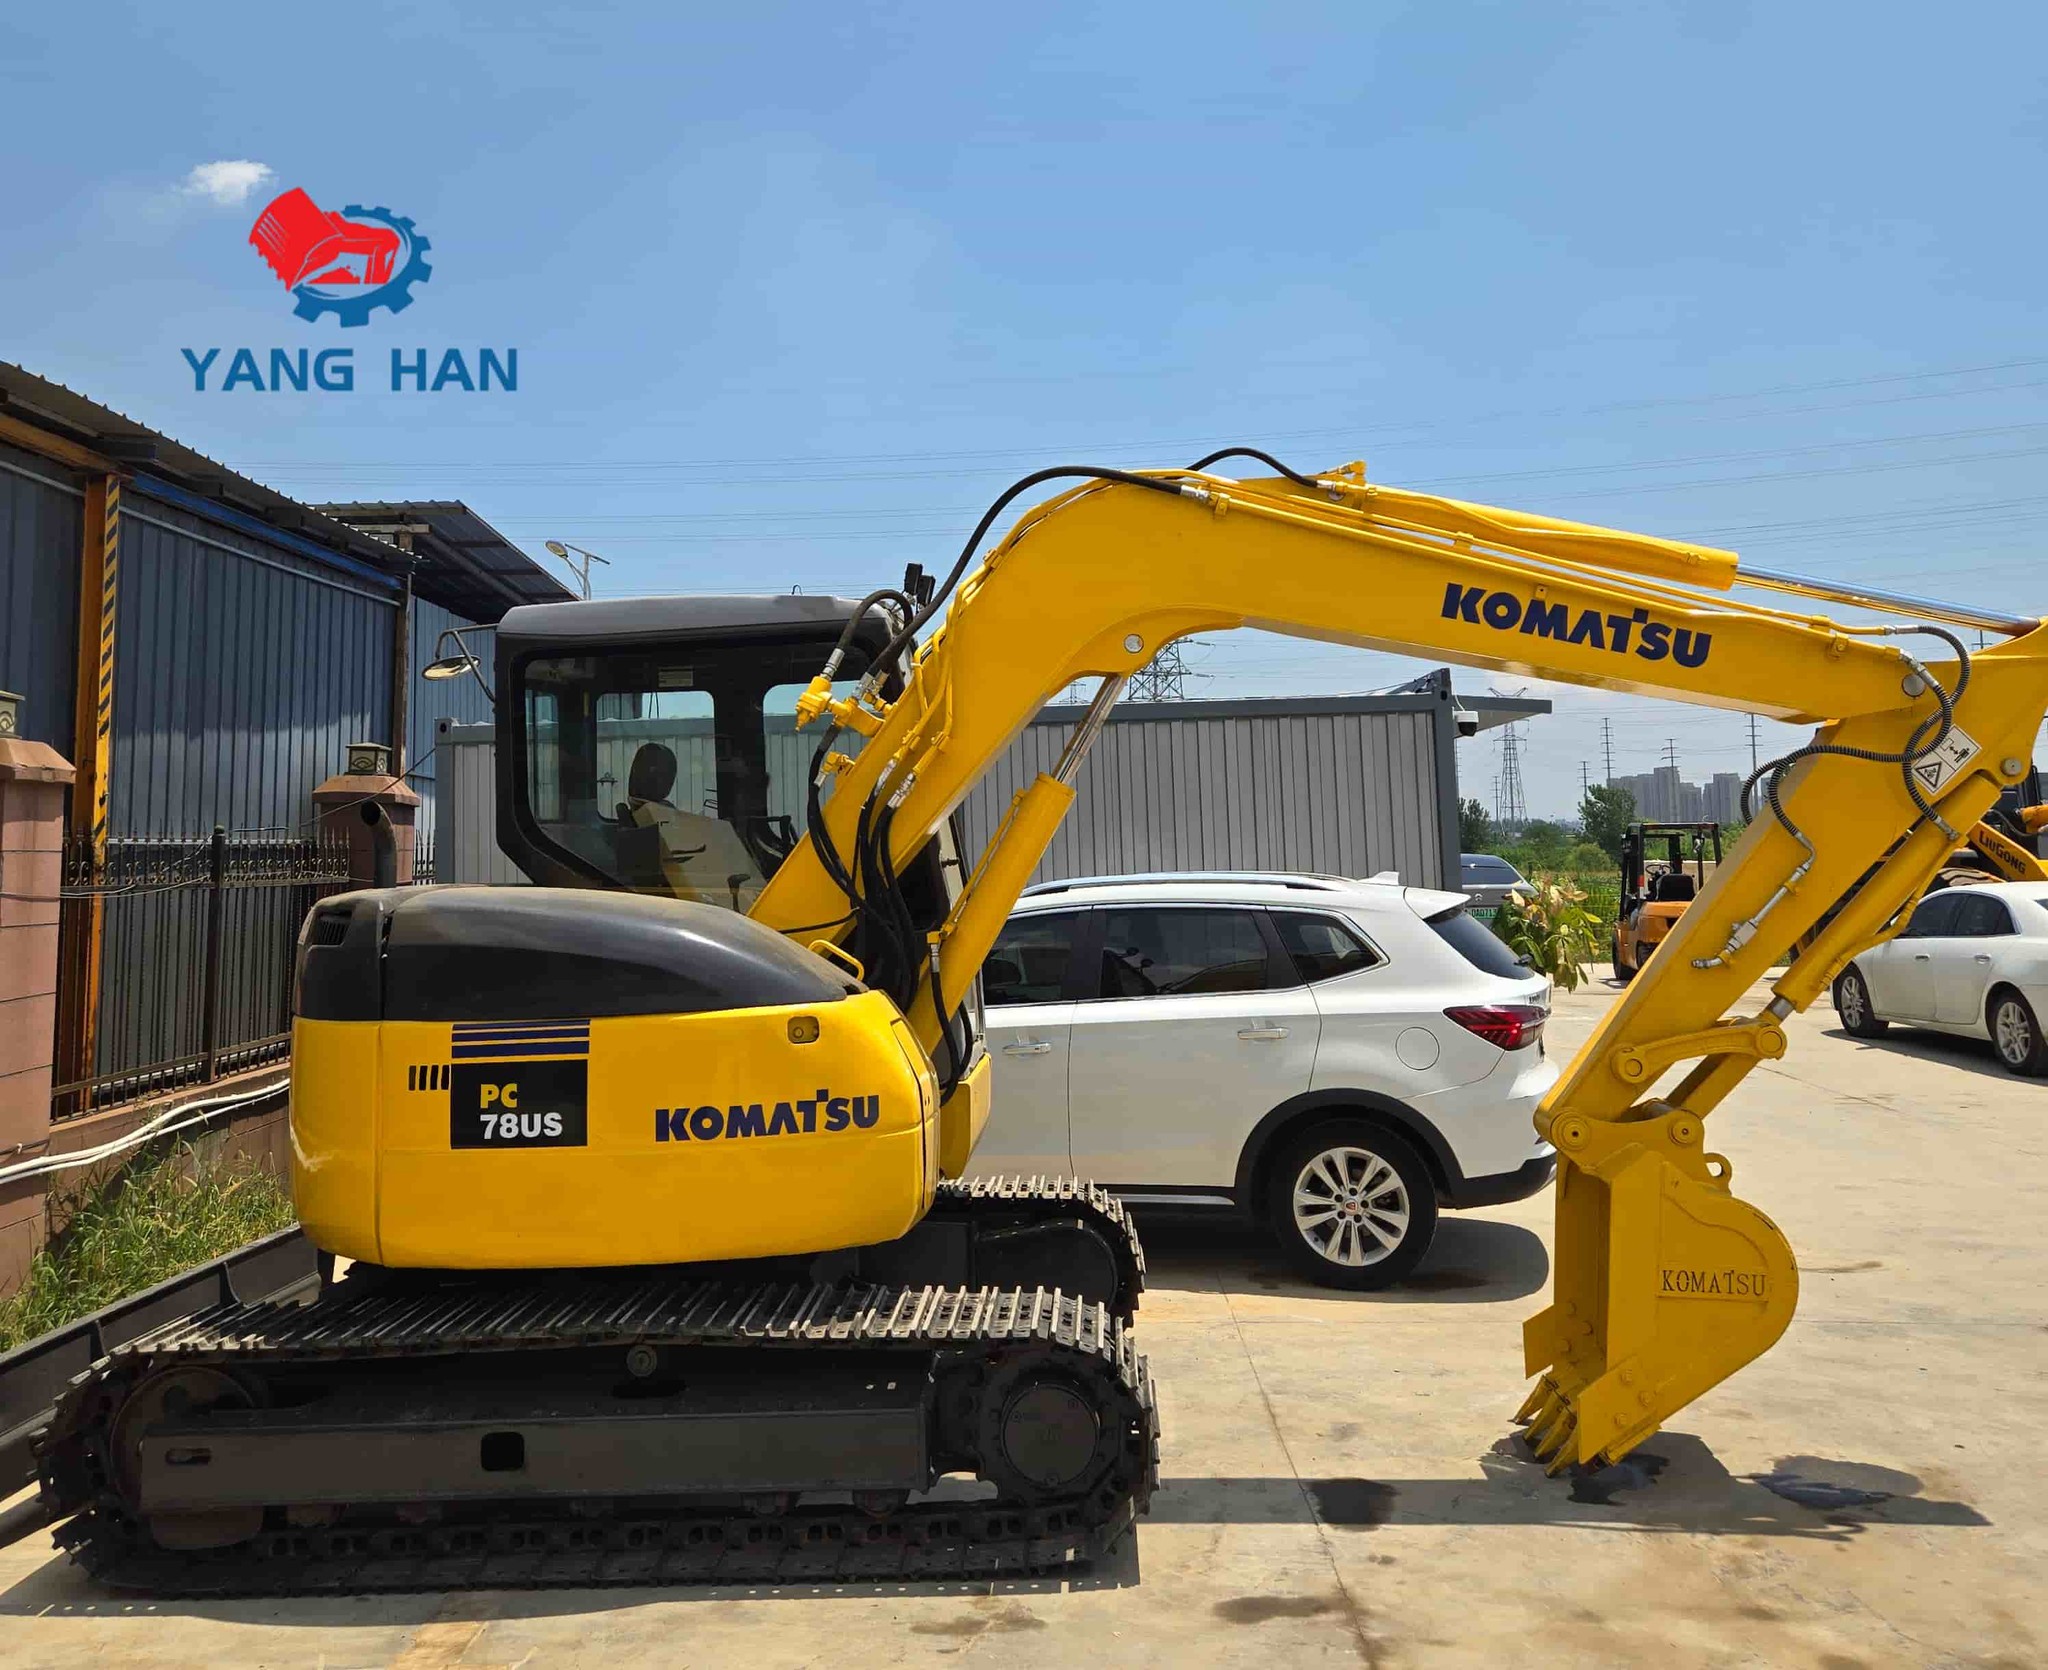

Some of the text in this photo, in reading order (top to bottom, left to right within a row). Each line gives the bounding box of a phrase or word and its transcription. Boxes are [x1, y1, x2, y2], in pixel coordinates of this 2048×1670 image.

[1441, 582, 1712, 668] KOMATSU
[480, 1083, 518, 1109] PC
[480, 1112, 563, 1139] 78US
[655, 1089, 879, 1142] KOMATSU
[1662, 1269, 1767, 1296] KOMATSU
